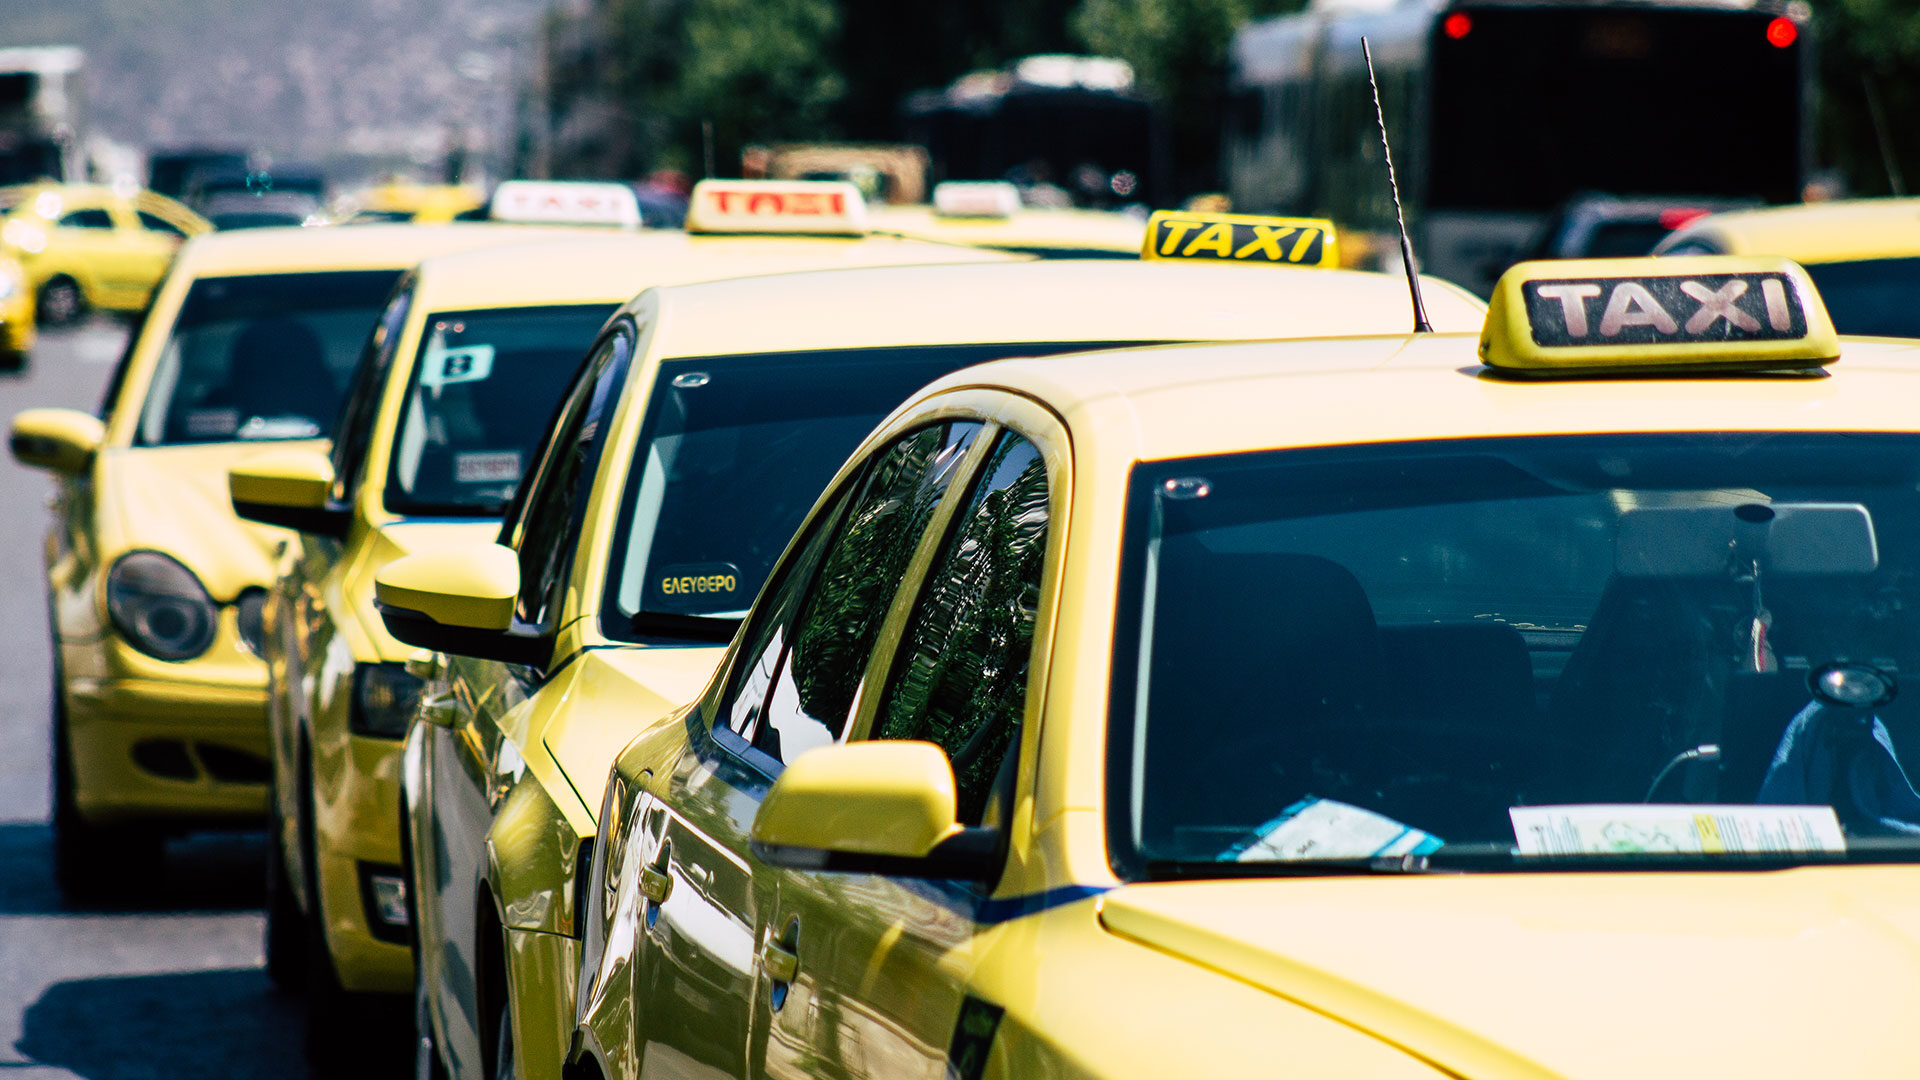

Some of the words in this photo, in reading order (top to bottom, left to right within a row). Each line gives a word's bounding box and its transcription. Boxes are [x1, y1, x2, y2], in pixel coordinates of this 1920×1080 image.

[1160, 220, 1321, 262] TAXI
[1537, 278, 1791, 337] TAXI
[662, 575, 736, 594] ΕΛΕΥΘΕΡΟ
